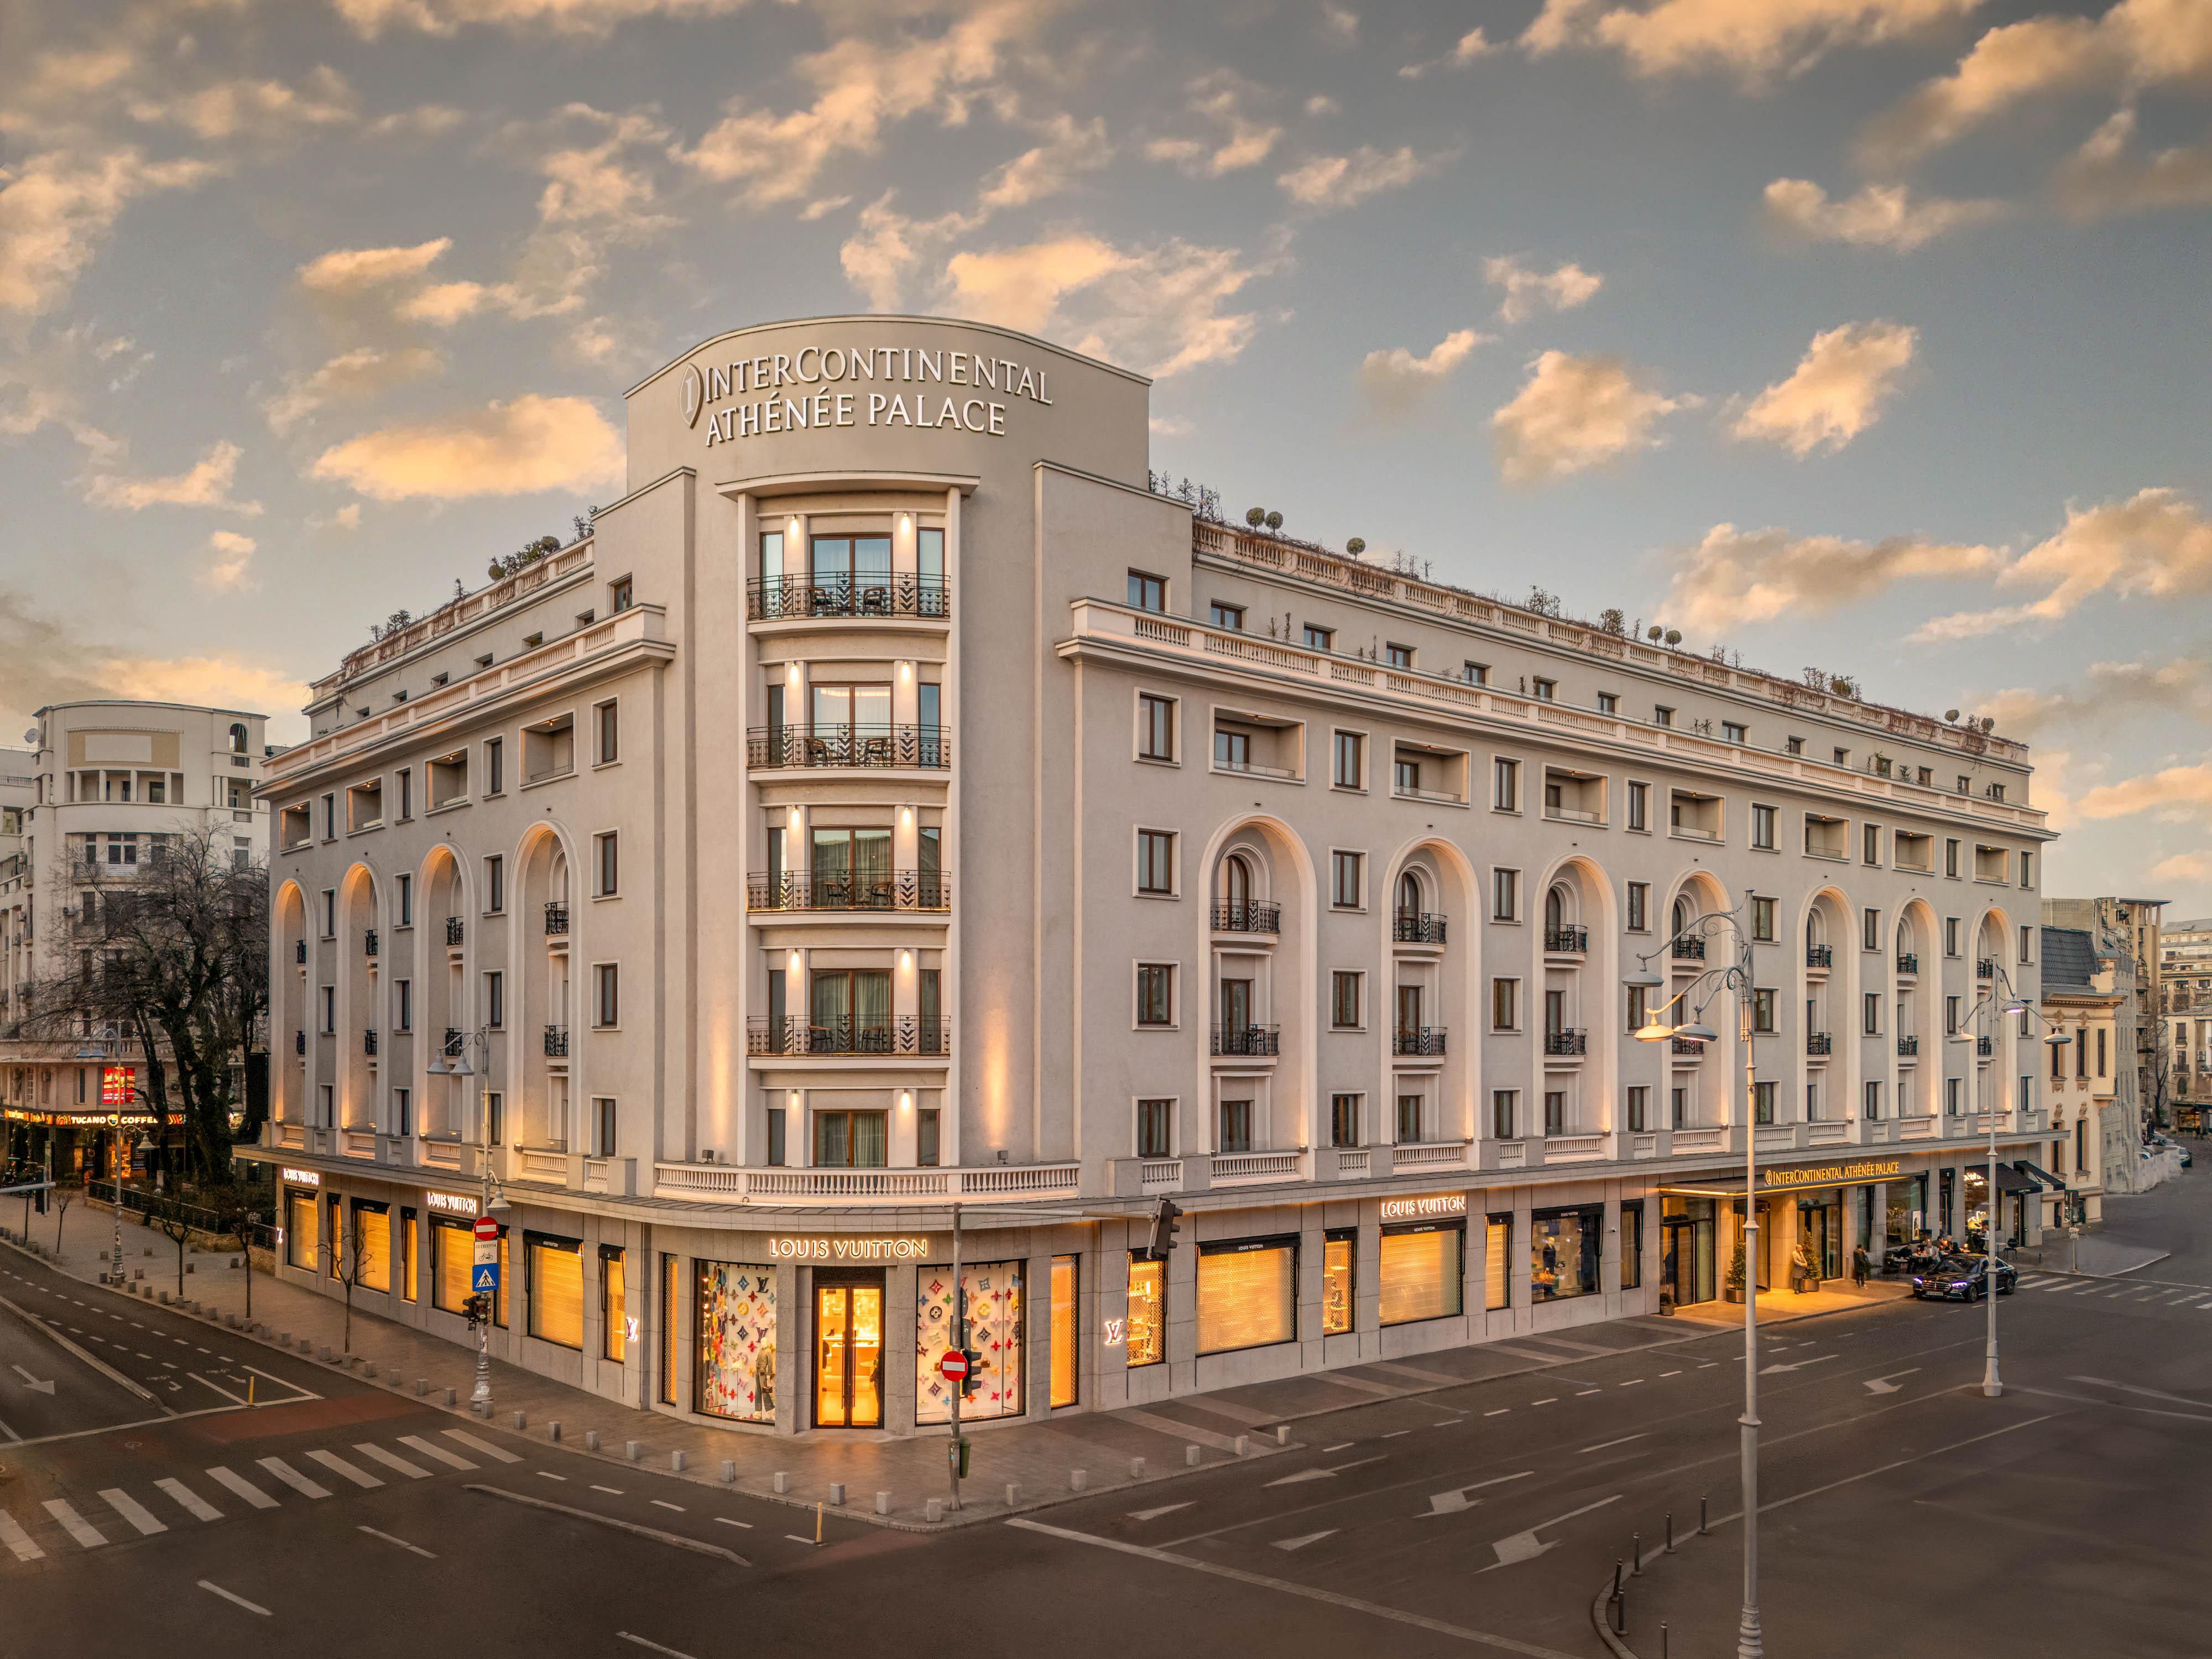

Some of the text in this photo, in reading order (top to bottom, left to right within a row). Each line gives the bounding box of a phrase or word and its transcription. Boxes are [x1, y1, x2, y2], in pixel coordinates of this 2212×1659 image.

[705, 346, 1052, 405] INTERCONTINENTAL
[706, 387, 1005, 447] ATHÉNÉE PALACE
[1773, 1161, 1899, 1185] INTERCONTINENTAL ATHÉNÉE PALACE
[427, 1192, 477, 1214] LOUIS VUITTON
[1383, 1196, 1465, 1217] LOUIS VUITTON
[770, 1239, 927, 1258] LOUIS VUITTON
